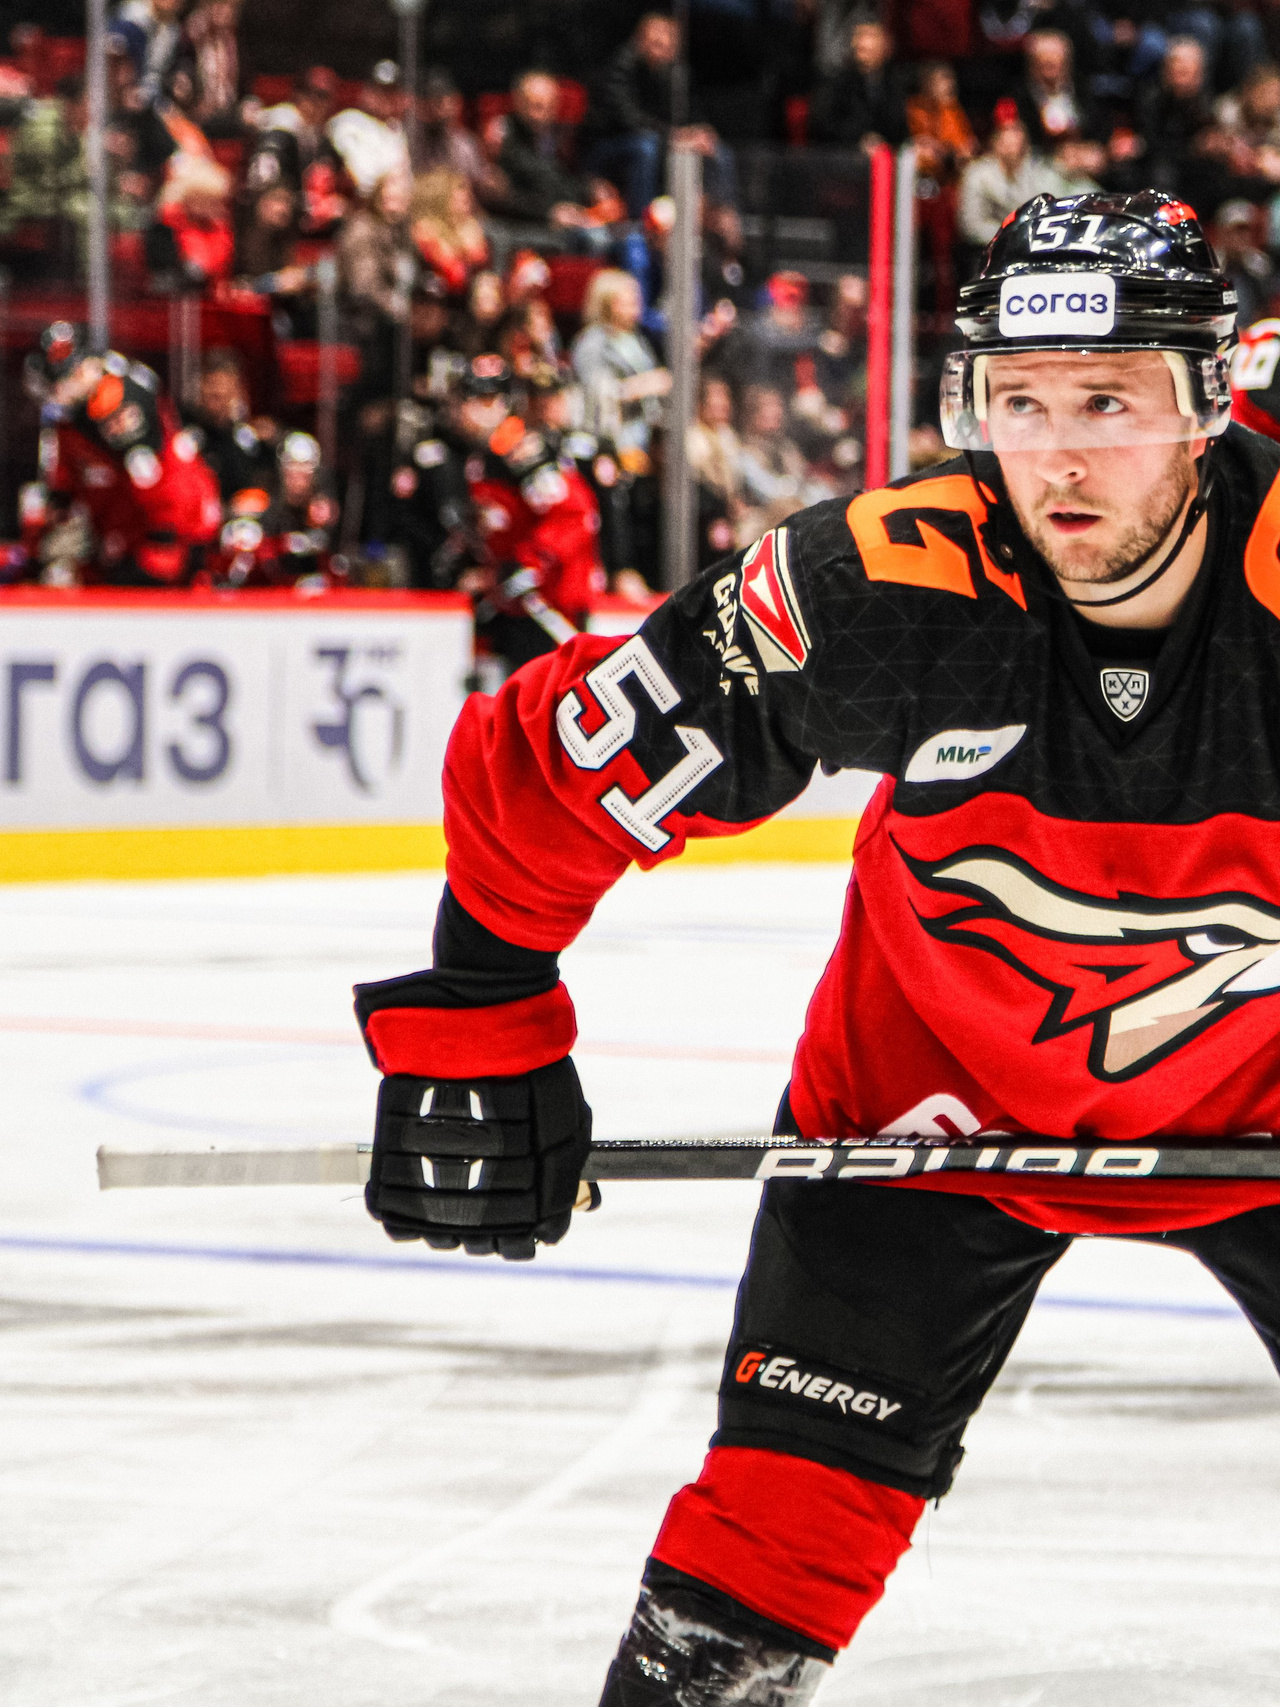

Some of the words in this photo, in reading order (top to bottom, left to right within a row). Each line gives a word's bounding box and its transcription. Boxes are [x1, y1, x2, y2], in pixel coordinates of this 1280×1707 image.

[1030, 213, 1104, 255] 51
[556, 635, 724, 853] 51
[936, 745, 992, 765] МИР
